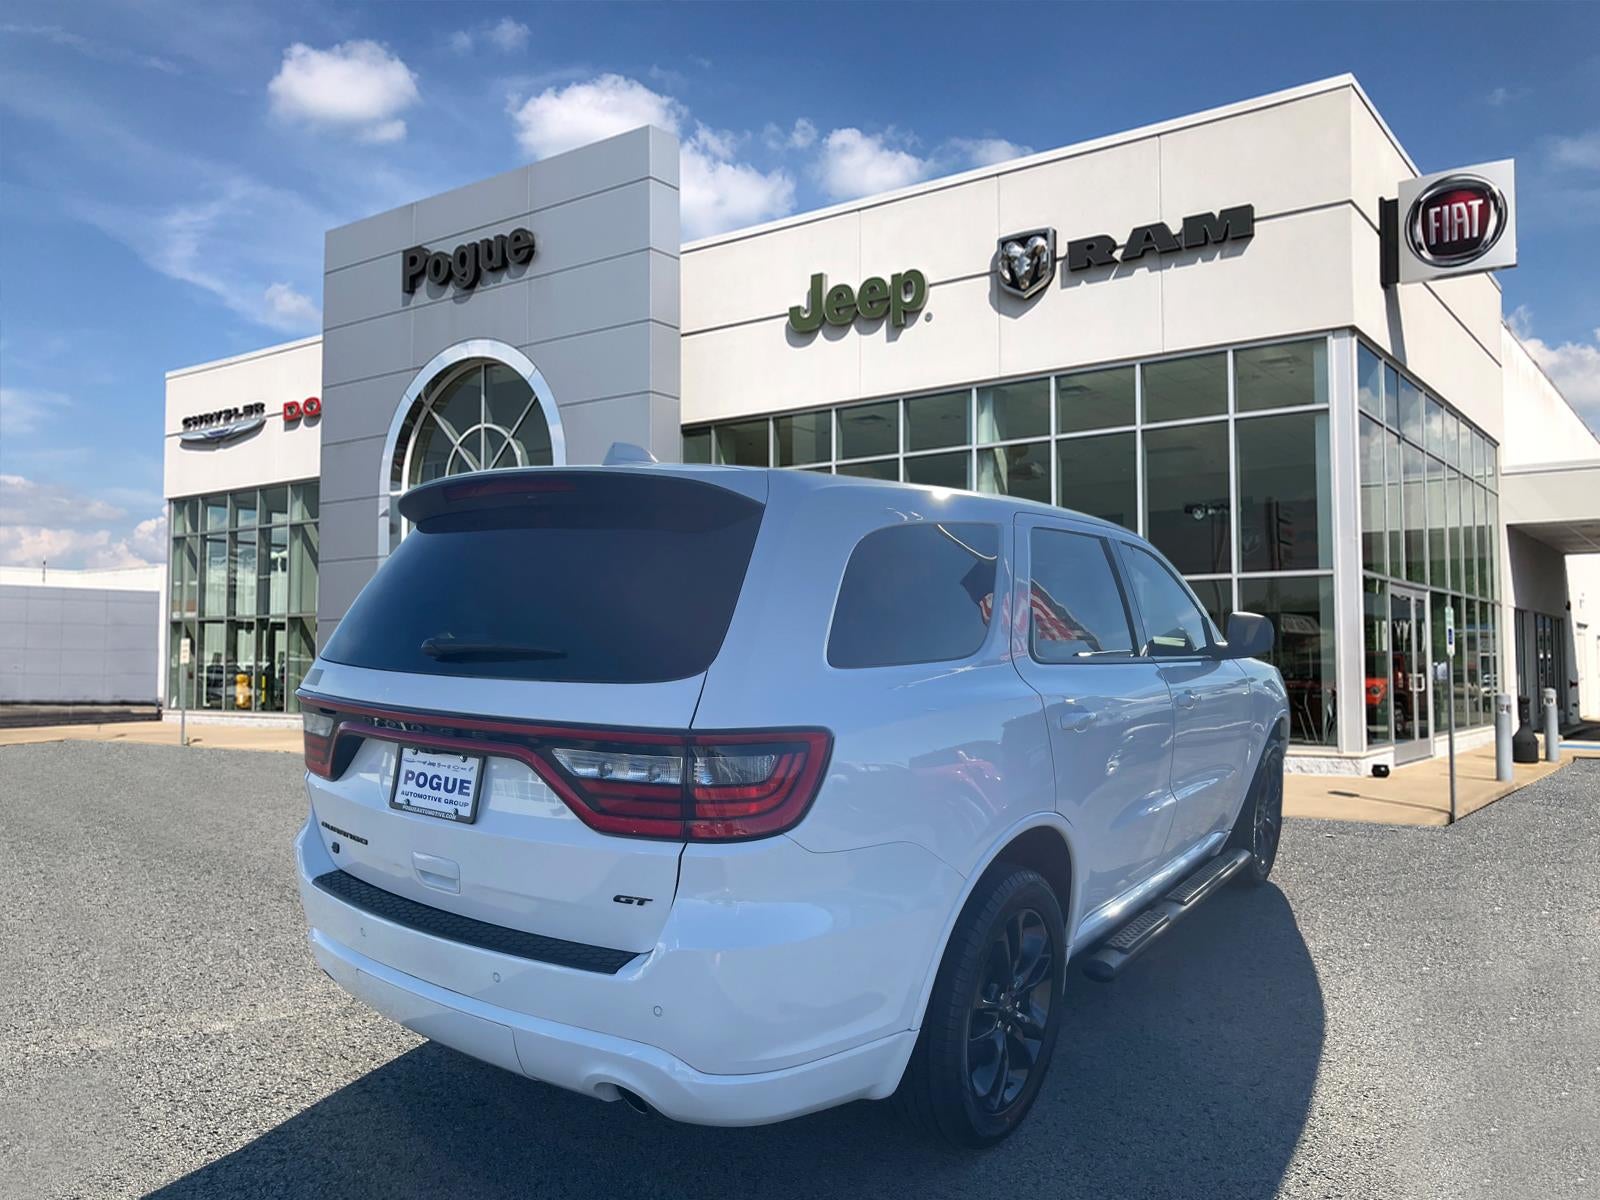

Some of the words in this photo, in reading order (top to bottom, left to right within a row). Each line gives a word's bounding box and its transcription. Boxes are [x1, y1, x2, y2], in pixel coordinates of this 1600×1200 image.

[1067, 204, 1254, 271] RAM
[1428, 199, 1483, 245] FIAT
[402, 228, 535, 294] Pogue
[788, 268, 929, 334] Jeep
[182, 402, 265, 429] CHRYSLER
[400, 790, 442, 803] AUTOMOTIVE
[443, 798, 469, 808] GROUP
[403, 769, 472, 797] POGUE
[613, 895, 653, 906] GT
